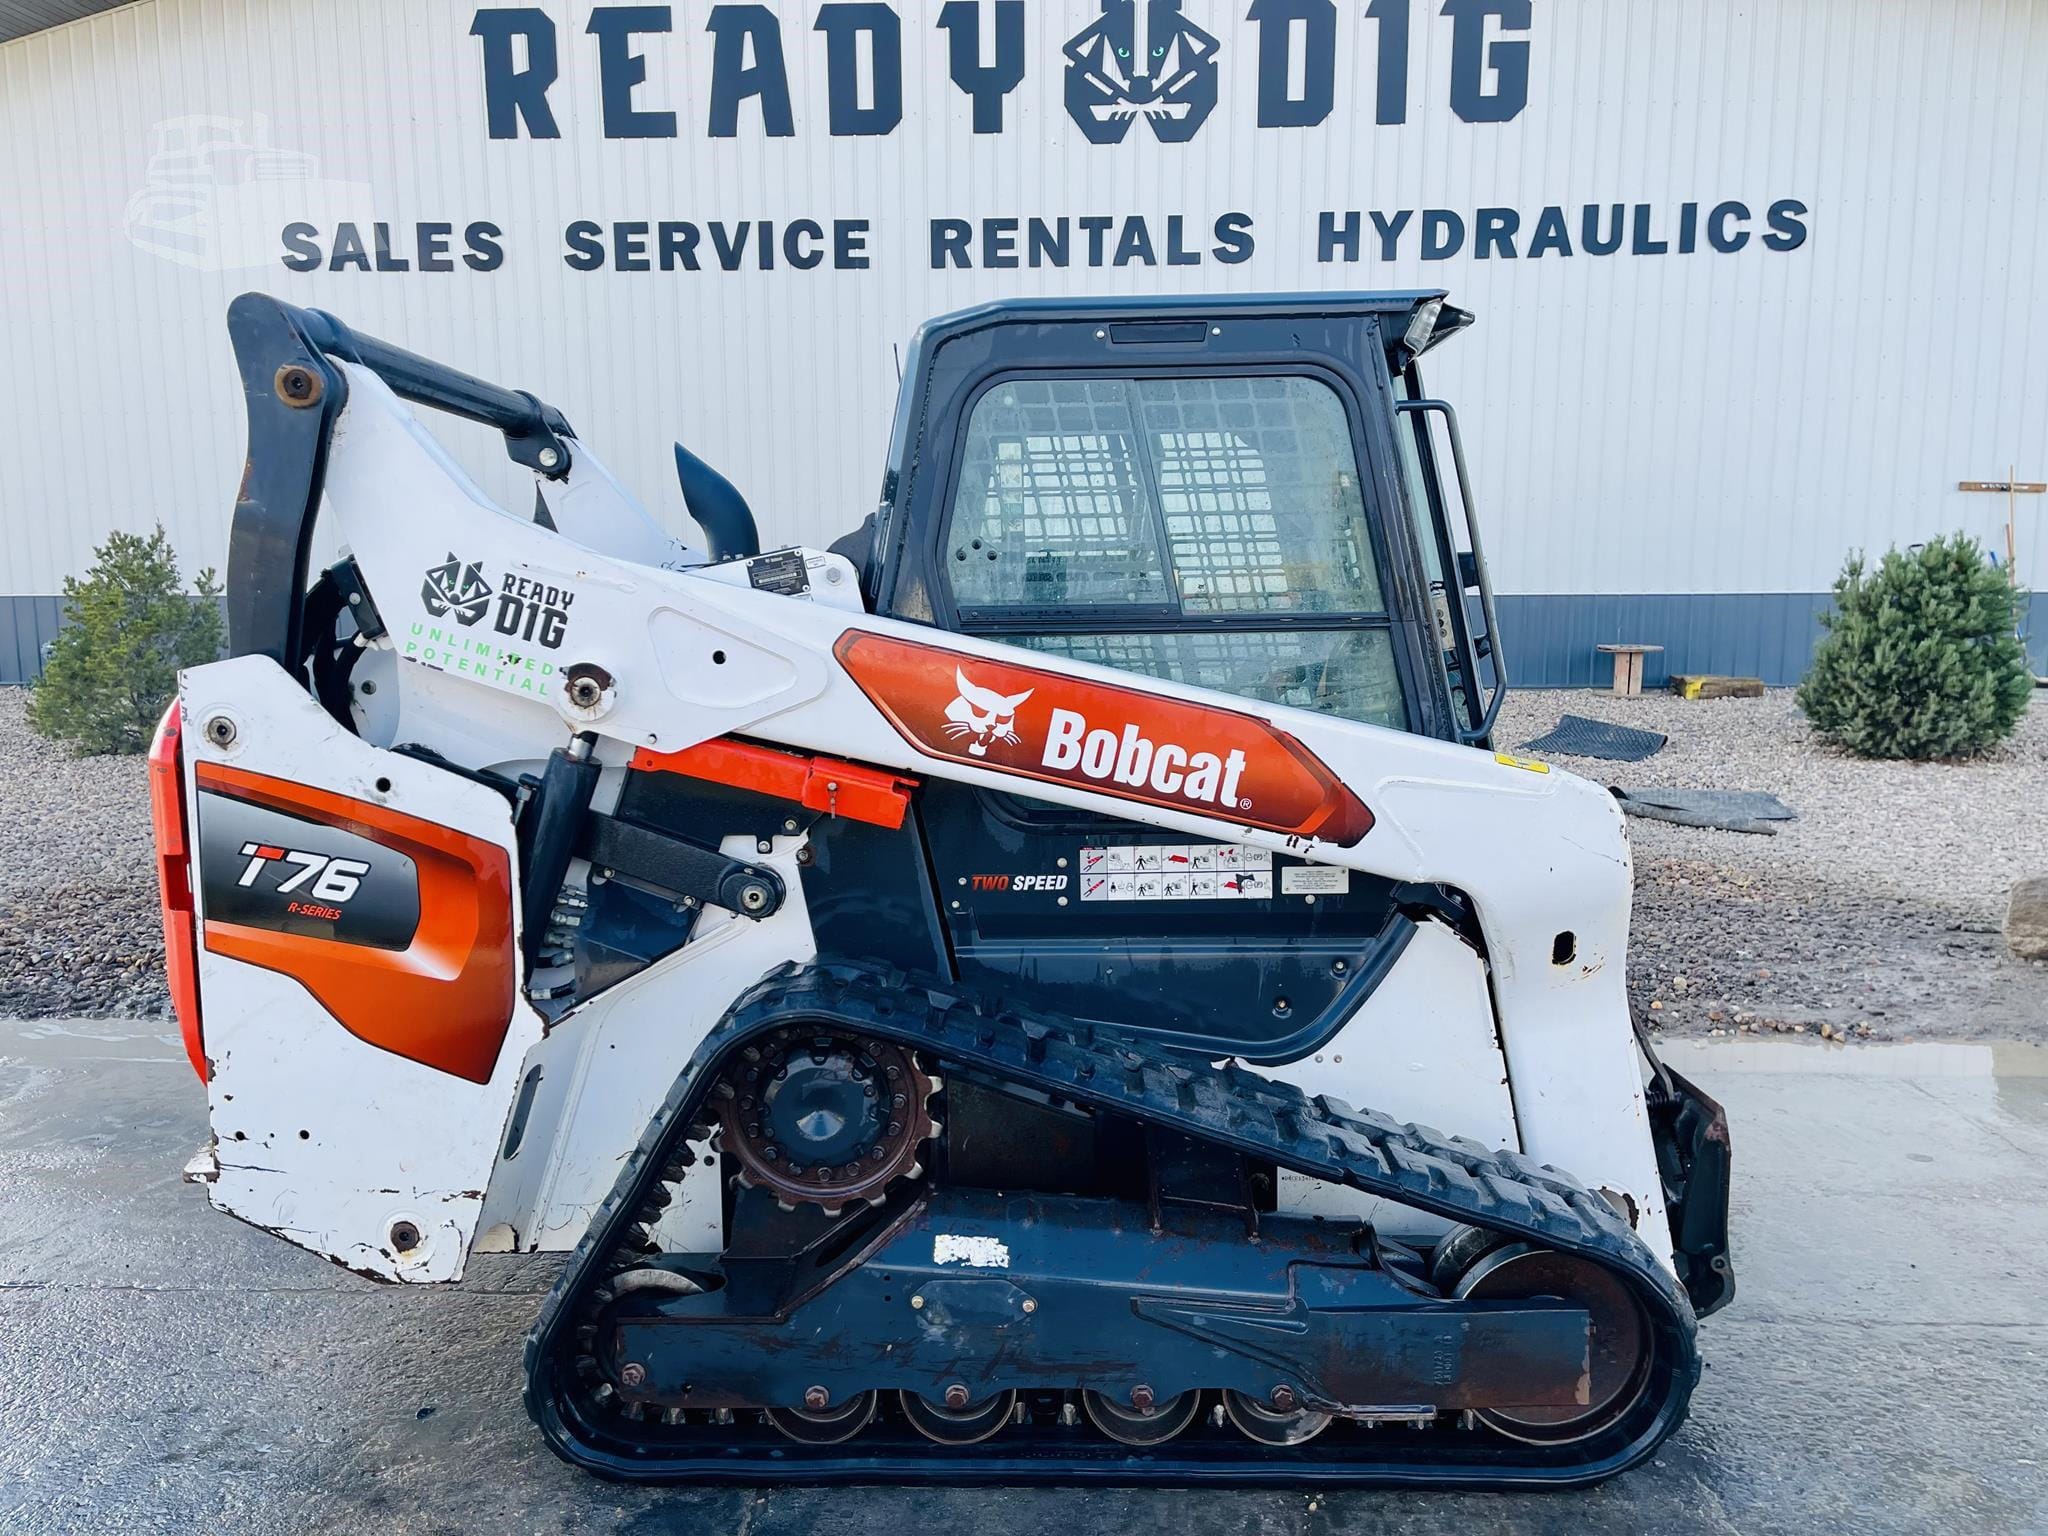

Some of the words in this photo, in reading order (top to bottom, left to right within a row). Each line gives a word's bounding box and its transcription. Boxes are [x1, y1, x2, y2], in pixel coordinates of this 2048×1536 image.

[469, 1, 1025, 140] READY
[281, 221, 503, 272] SALES
[564, 219, 870, 272] SERVICE
[930, 212, 1255, 270] RENTALS
[1318, 199, 1809, 263] HYDRAULICS
[501, 572, 575, 611] READY
[405, 641, 549, 696] POTENTIAL
[410, 622, 554, 676] UNLIMITED
[238, 842, 370, 902] T76
[971, 875, 1010, 891] TWO
[1012, 874, 1069, 891] SPEED
[287, 901, 343, 921] R-SERIES
